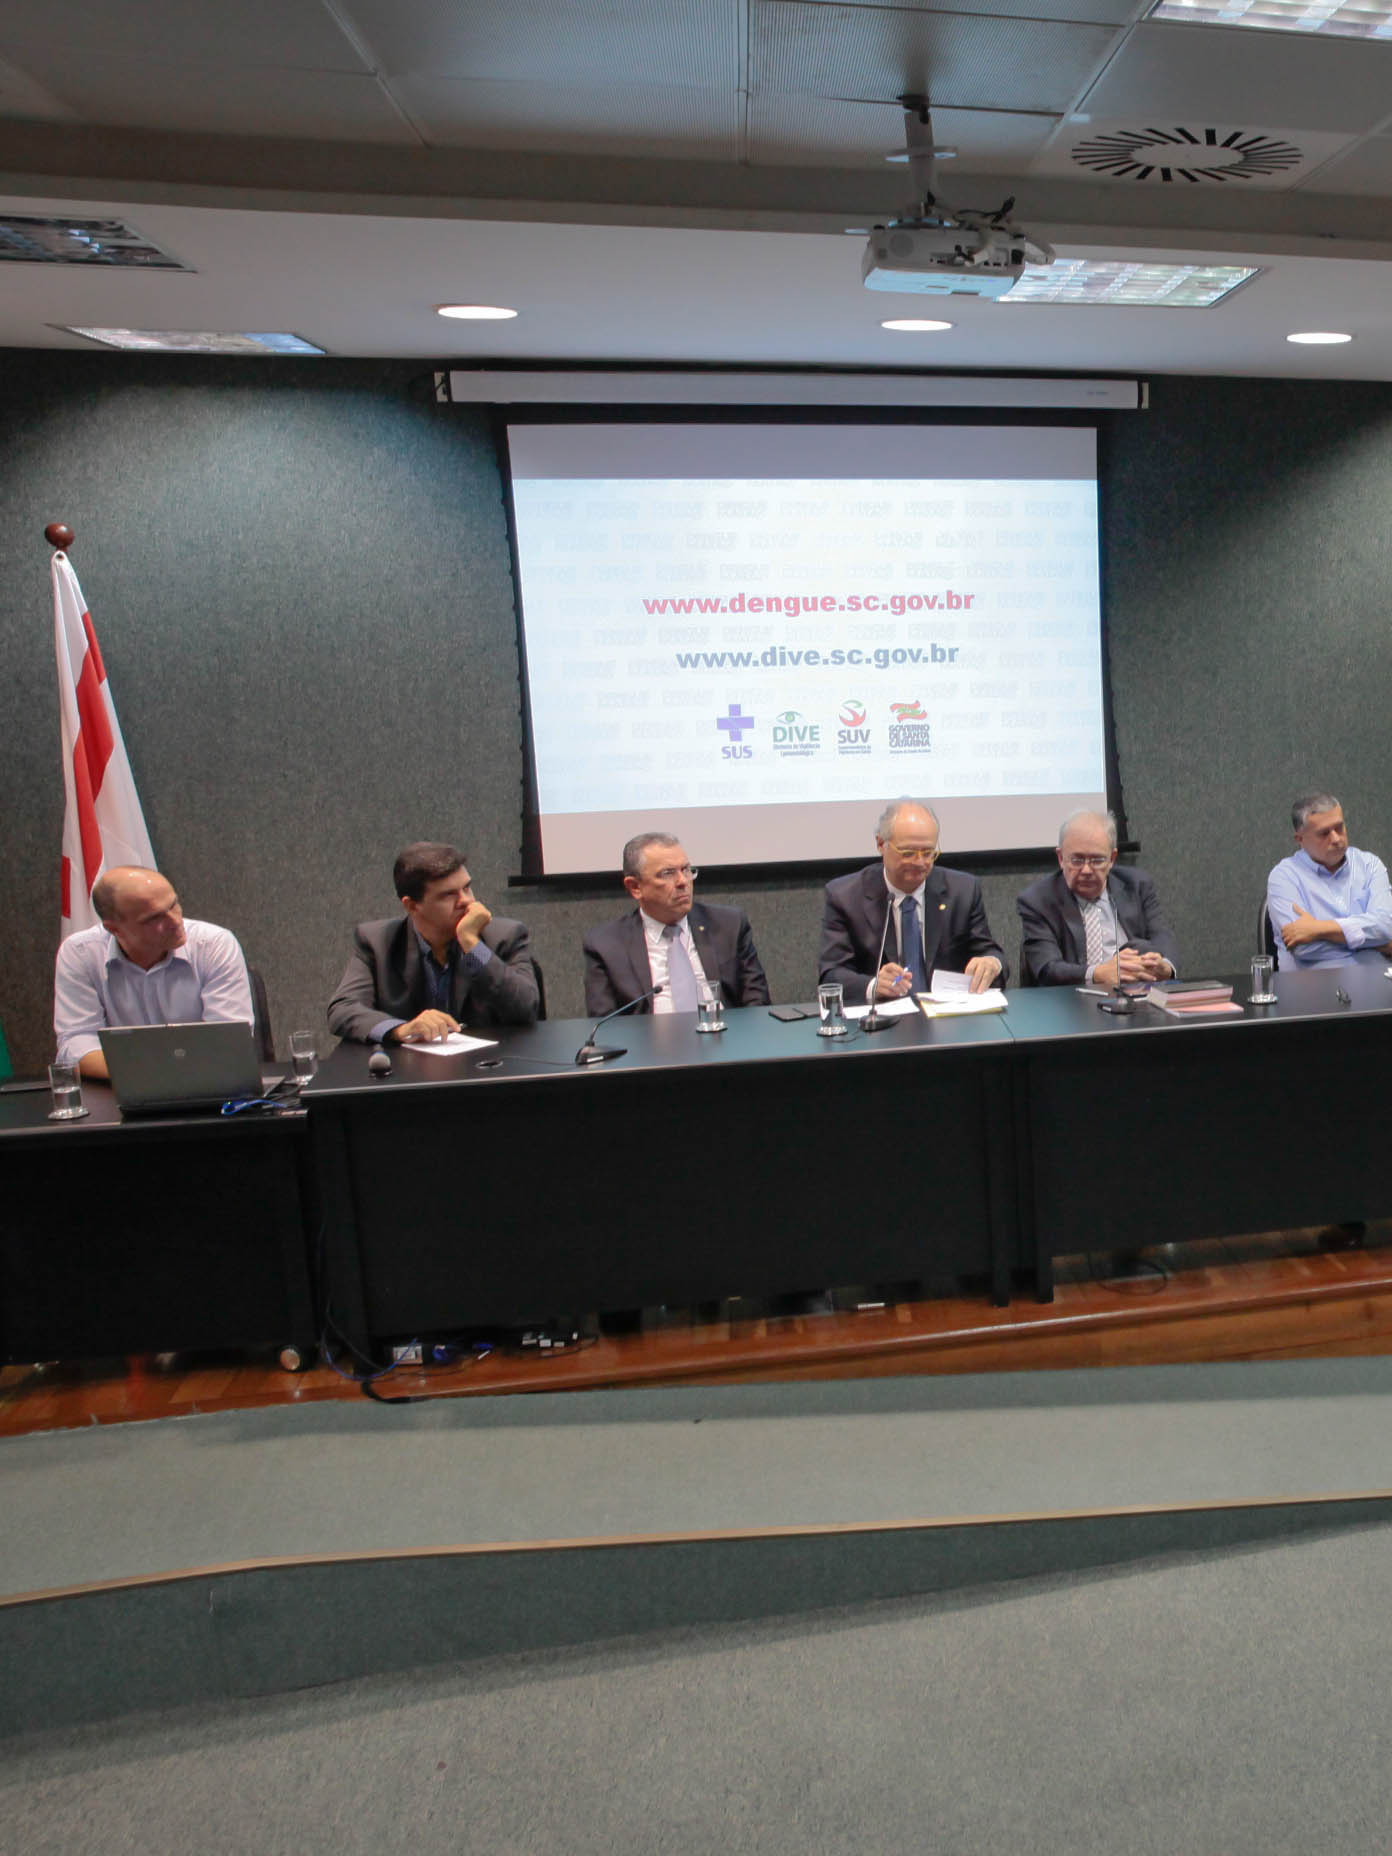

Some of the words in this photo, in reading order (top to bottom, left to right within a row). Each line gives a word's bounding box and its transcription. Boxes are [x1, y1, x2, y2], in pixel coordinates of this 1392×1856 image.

[642, 590, 976, 617] www.dengue.sc.gov.br
[675, 643, 960, 669] www.dive.sc.gov.br
[772, 725, 820, 743] DIVE
[888, 724, 930, 732] GOVERNO
[838, 729, 871, 744] SUV
[721, 745, 753, 759] SUS
